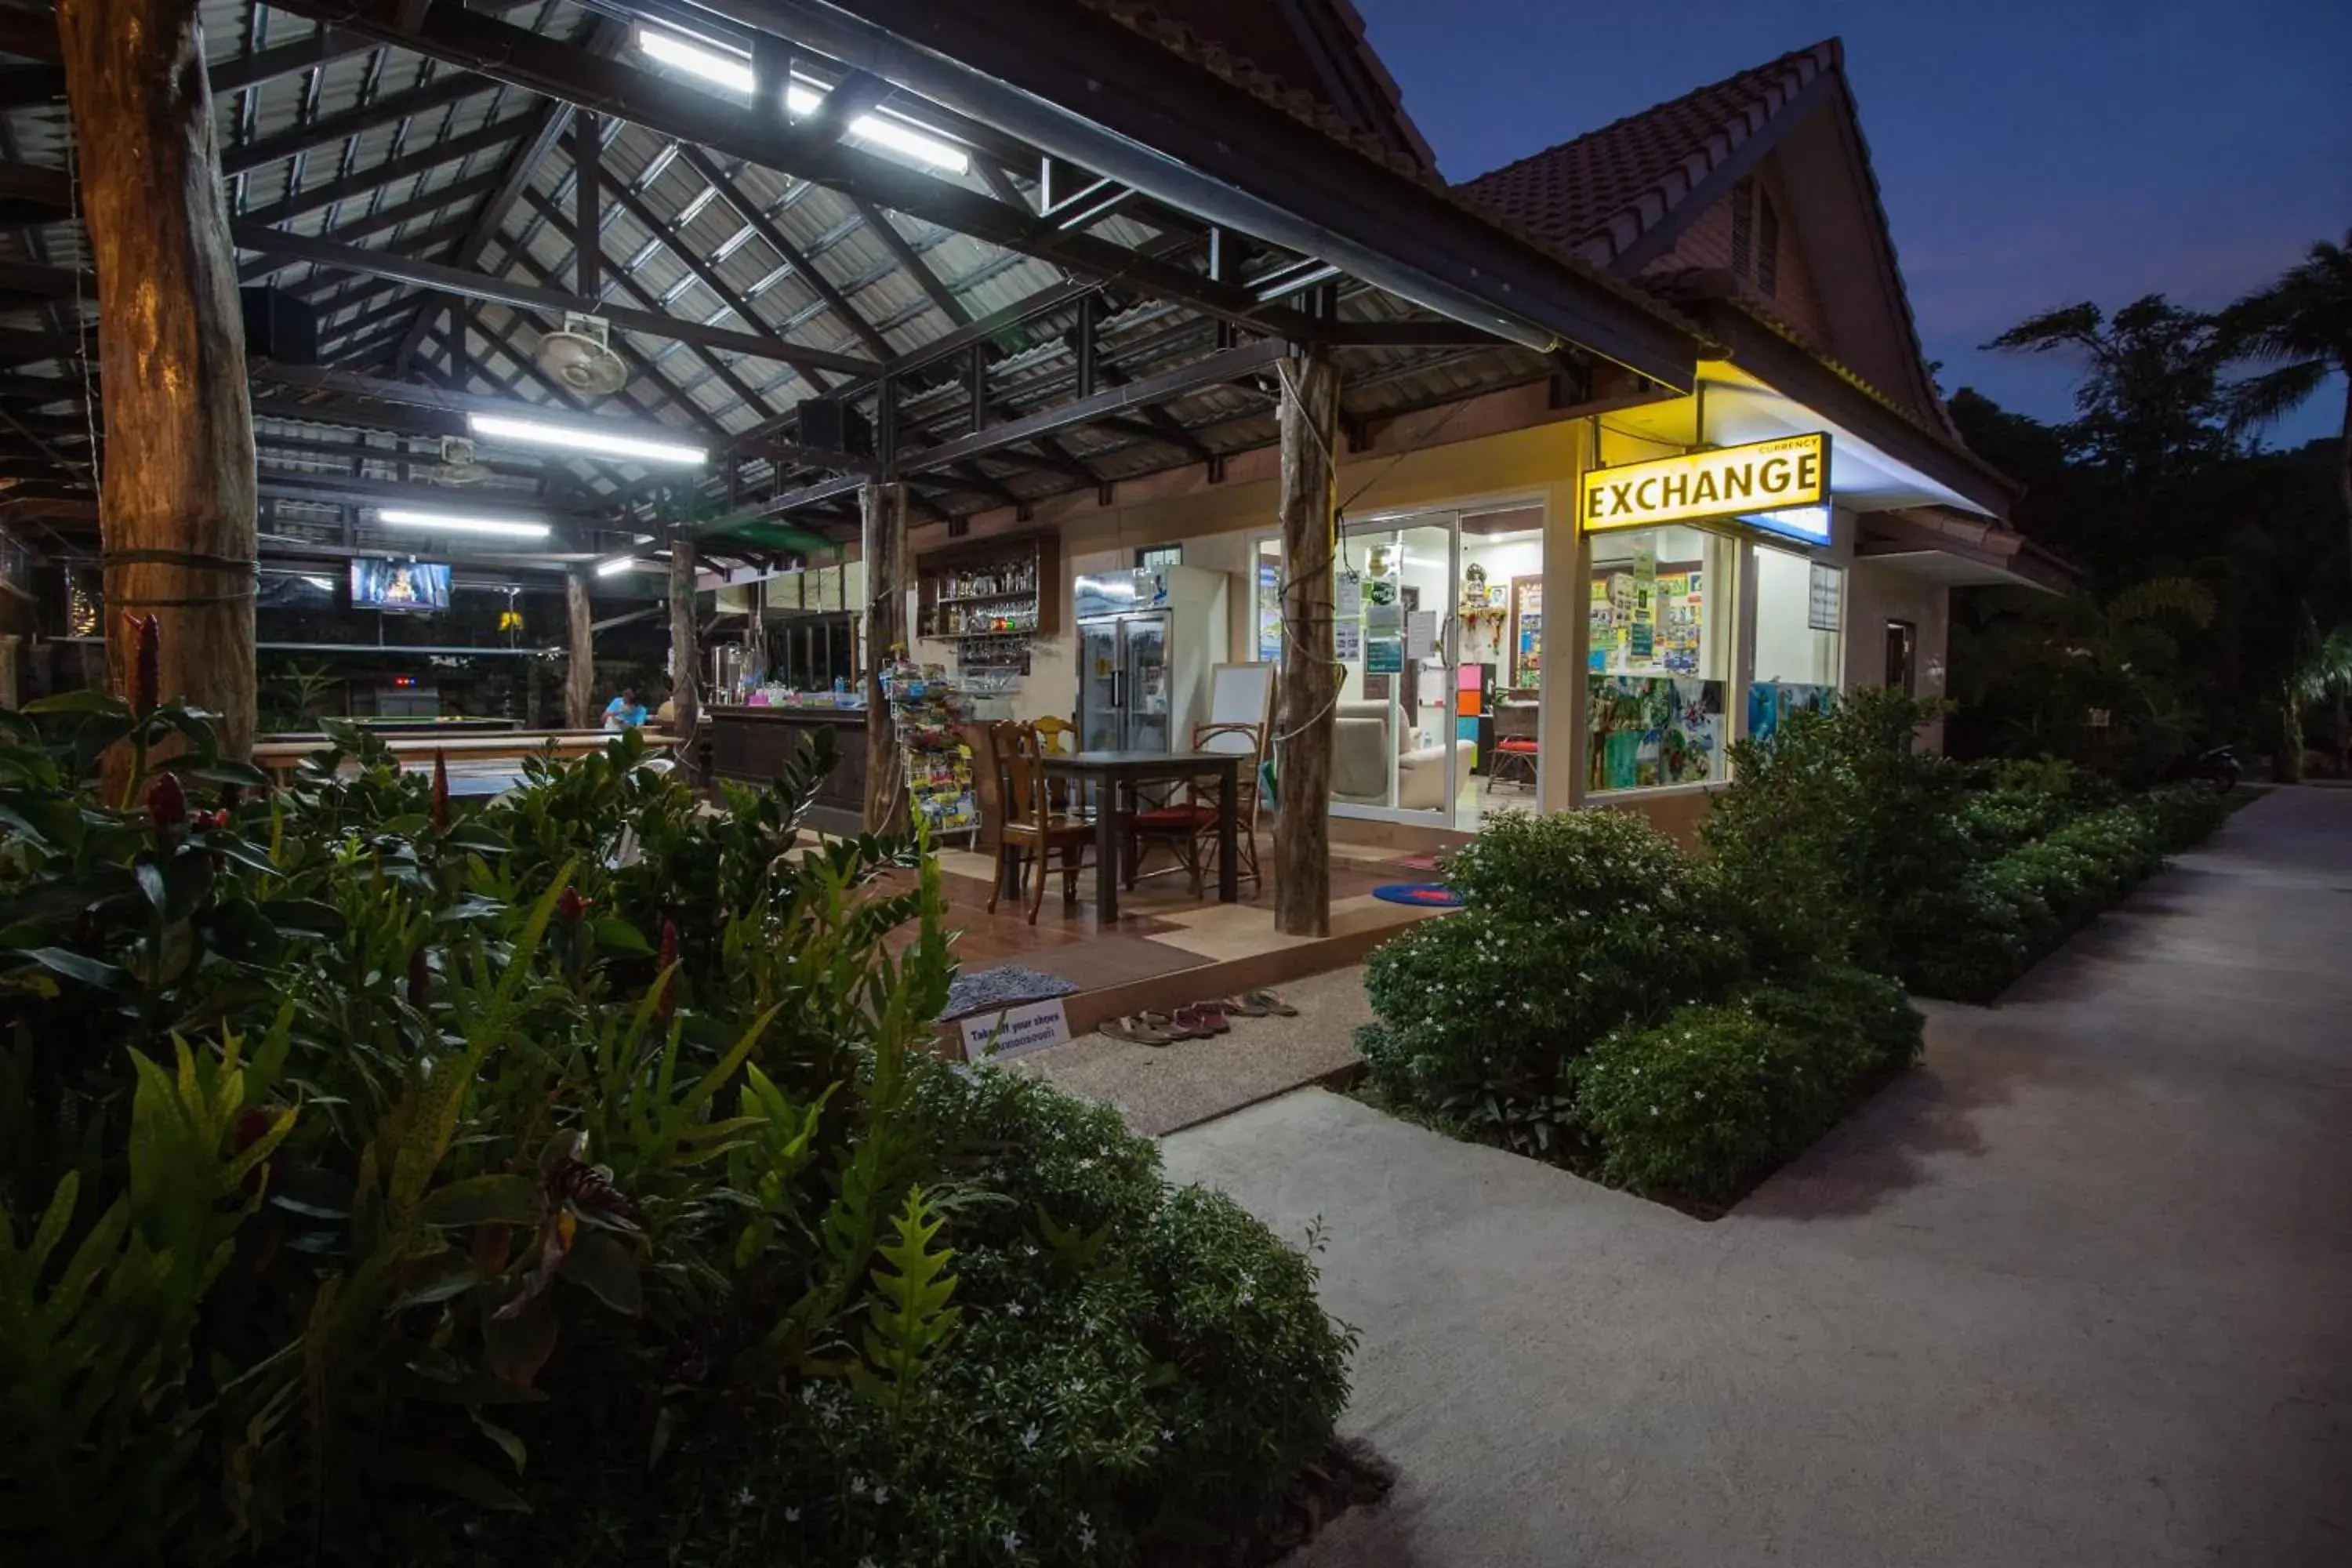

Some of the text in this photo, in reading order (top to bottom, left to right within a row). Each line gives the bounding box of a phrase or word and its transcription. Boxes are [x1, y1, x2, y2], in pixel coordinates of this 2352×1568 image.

[1759, 438, 1819, 456] CURRENCY
[1588, 452, 1817, 518] EXCHANGE
[1012, 1020, 1033, 1034] your
[1034, 1013, 1060, 1026] shoes
